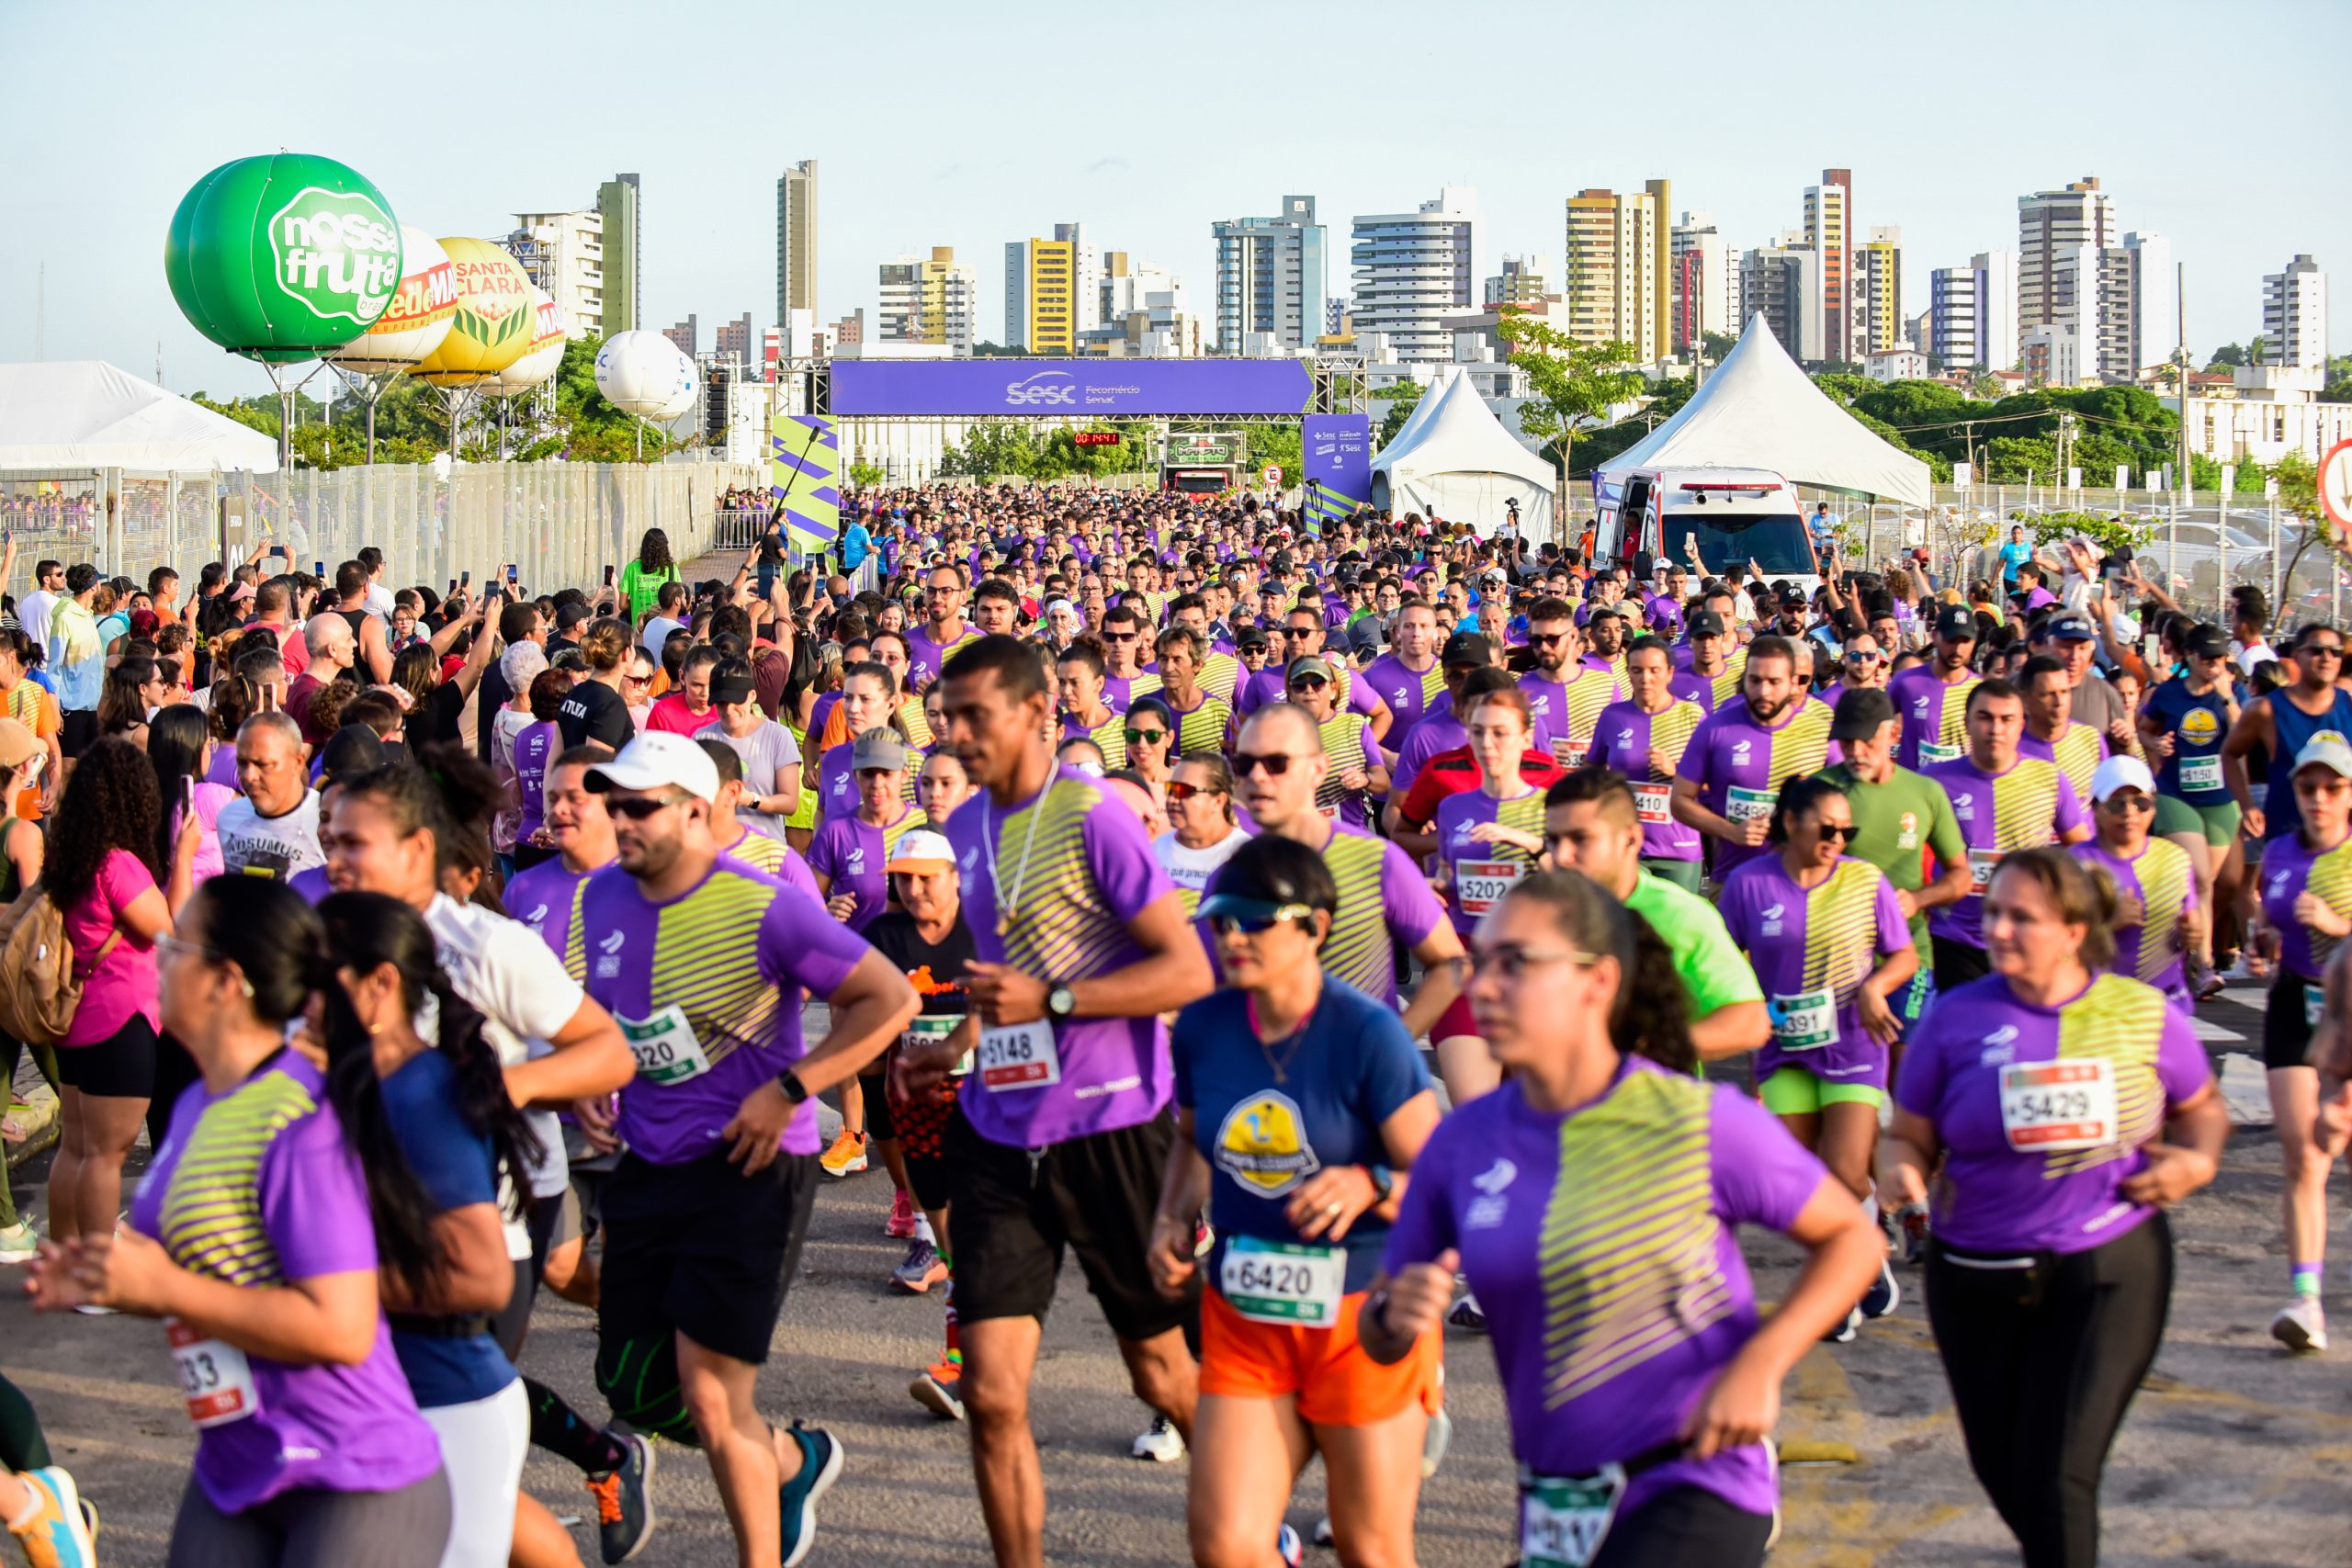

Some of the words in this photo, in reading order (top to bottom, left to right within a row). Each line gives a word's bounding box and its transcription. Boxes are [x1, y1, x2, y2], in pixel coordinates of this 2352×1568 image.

[457, 262, 514, 276] SANTA
[458, 276, 526, 295] CLARA
[1005, 376, 1076, 405] Sesc
[1085, 385, 1140, 395] Fecomércio
[1085, 396, 1115, 405] Senac
[1075, 434, 1117, 444] 00:14:41
[1345, 444, 1362, 452] Sesc
[1633, 796, 1662, 811] 410
[1465, 881, 1507, 899] 5202
[1779, 1013, 1819, 1034] 391
[987, 1032, 1033, 1064] 5148
[2020, 1090, 2090, 1122] 5429
[1240, 1258, 1314, 1295] 6420
